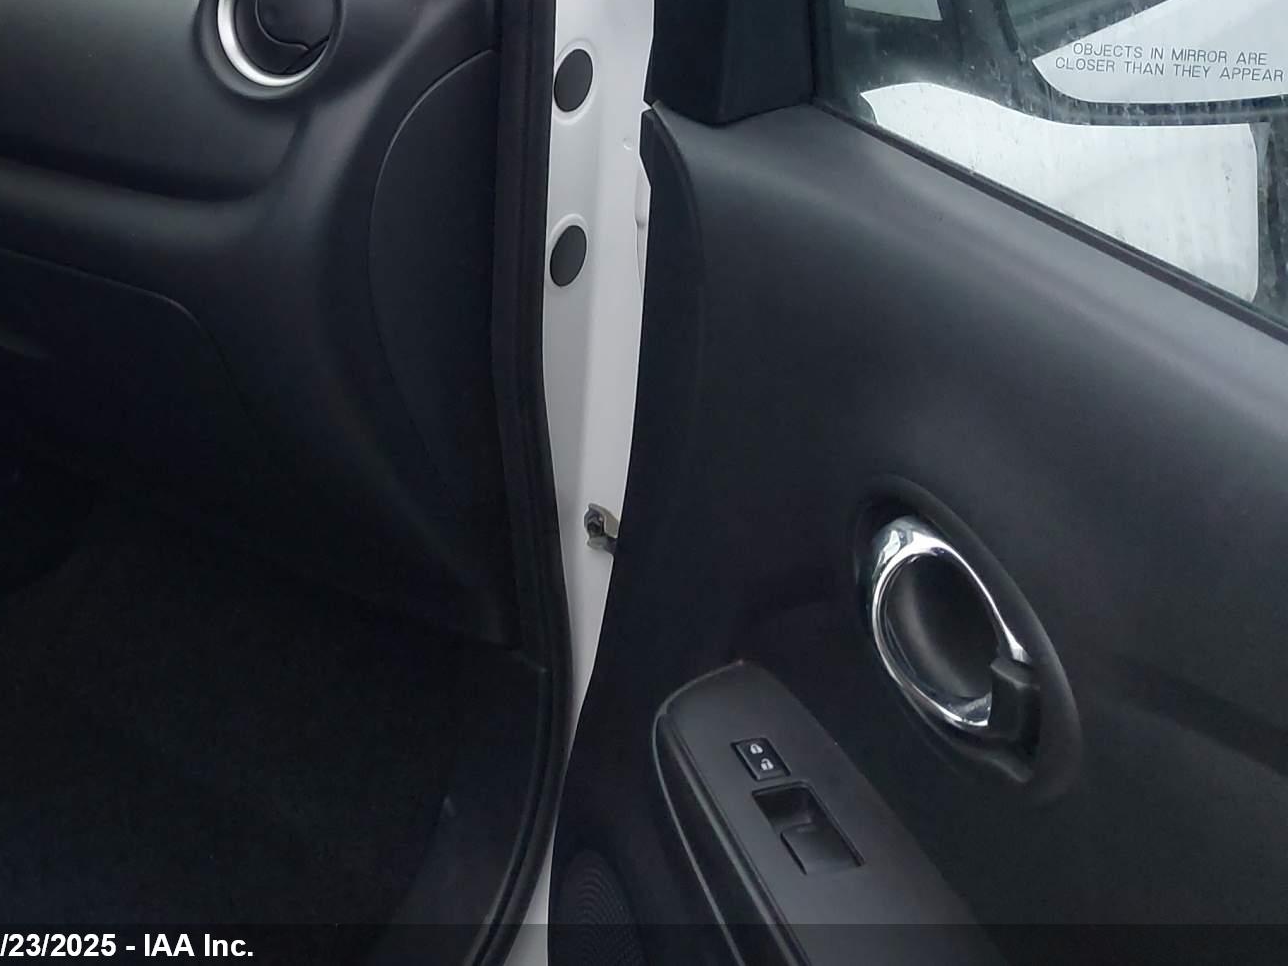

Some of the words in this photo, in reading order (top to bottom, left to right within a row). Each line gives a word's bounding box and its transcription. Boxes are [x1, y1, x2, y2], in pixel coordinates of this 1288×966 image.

[1072, 42, 1143, 59] OBJECTS
[1149, 46, 1164, 61] IN
[1171, 48, 1228, 64] MIRROR
[1235, 52, 1268, 66] ARE
[1055, 56, 1115, 73] CLOSER
[1123, 60, 1165, 76] THAN
[1173, 63, 1212, 78] THEY
[1219, 67, 1284, 82] APPEAR
